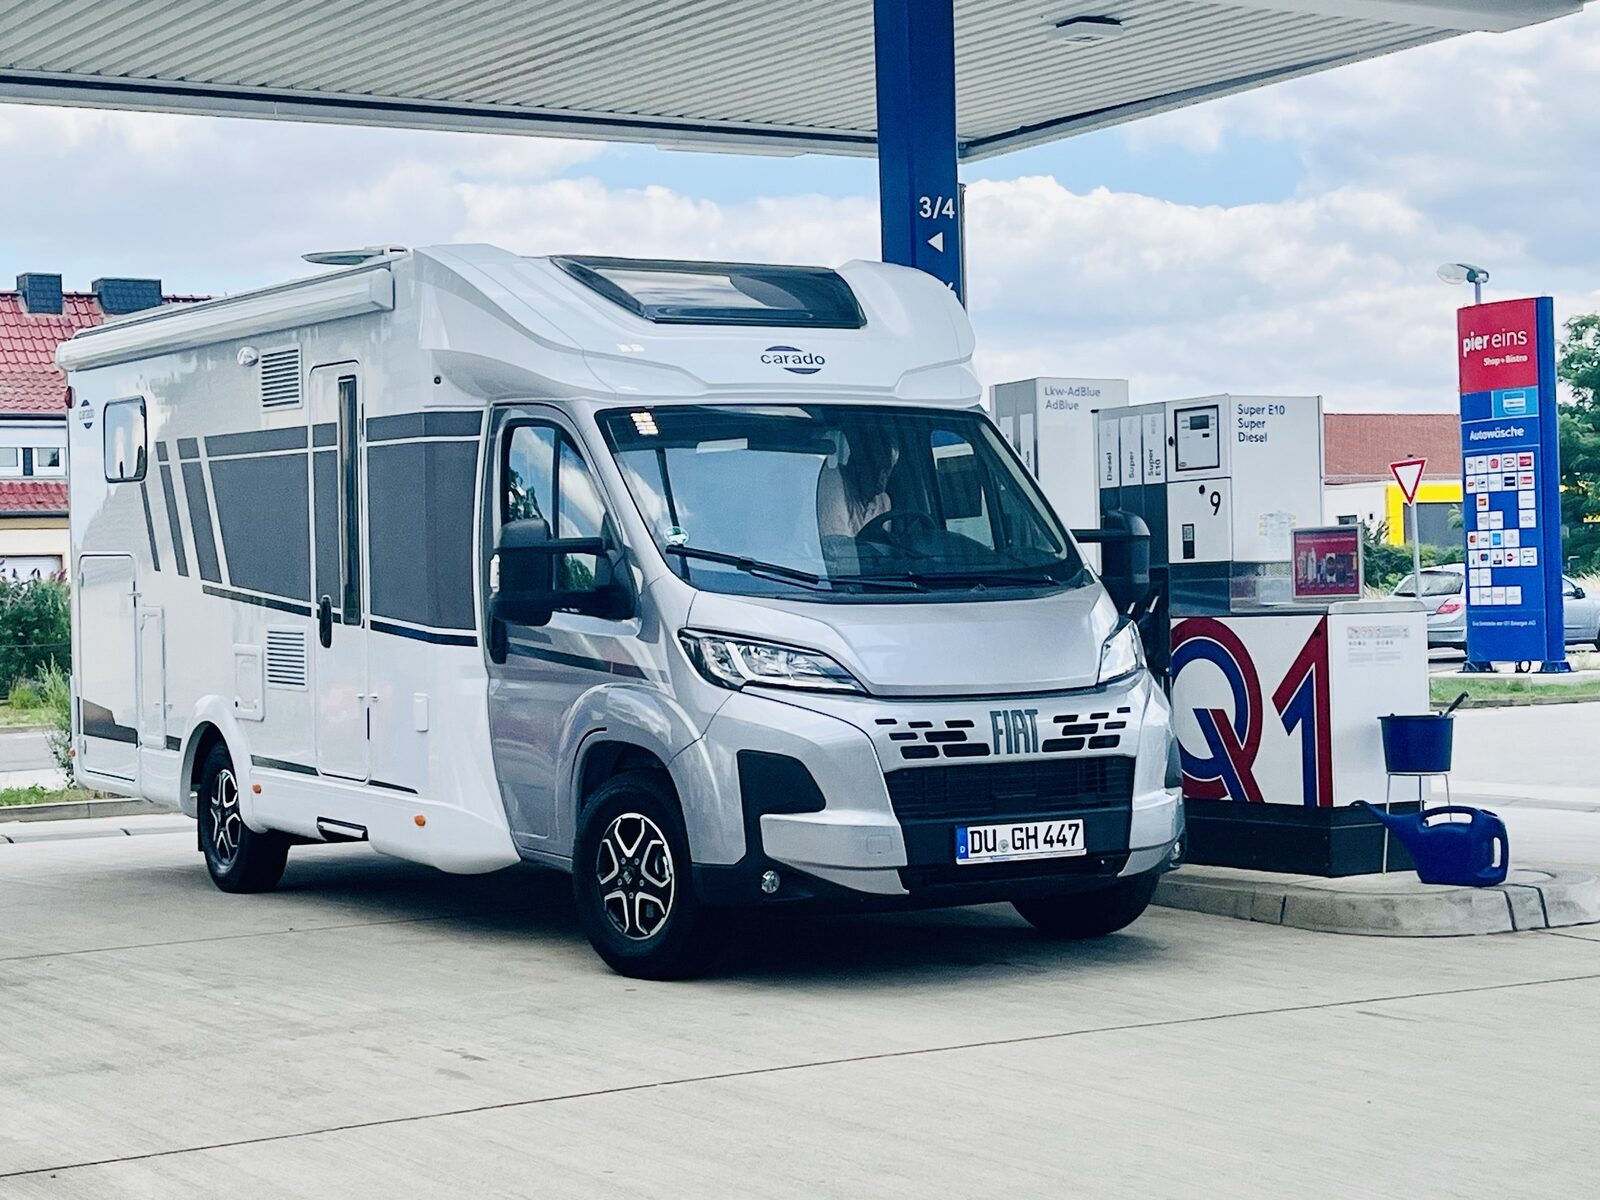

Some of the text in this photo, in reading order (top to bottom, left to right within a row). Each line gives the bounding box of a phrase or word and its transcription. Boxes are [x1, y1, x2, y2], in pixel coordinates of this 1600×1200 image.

[919, 196, 955, 219] 3/4
[1463, 328, 1527, 358] pier eins
[760, 353, 826, 365] carado
[1044, 385, 1101, 397] Lkw-AdBlue
[1045, 399, 1080, 411] AdBlue
[1237, 404, 1286, 416] Super E10
[1237, 418, 1266, 430] Super
[1469, 425, 1525, 442] Autowäsche
[1238, 431, 1268, 443] Diesel
[1128, 451, 1136, 478] Super
[1209, 490, 1222, 516] 9
[1170, 614, 1334, 807] Q1
[990, 709, 1038, 755] FIAT
[960, 823, 1080, 854] D DU GH 447
